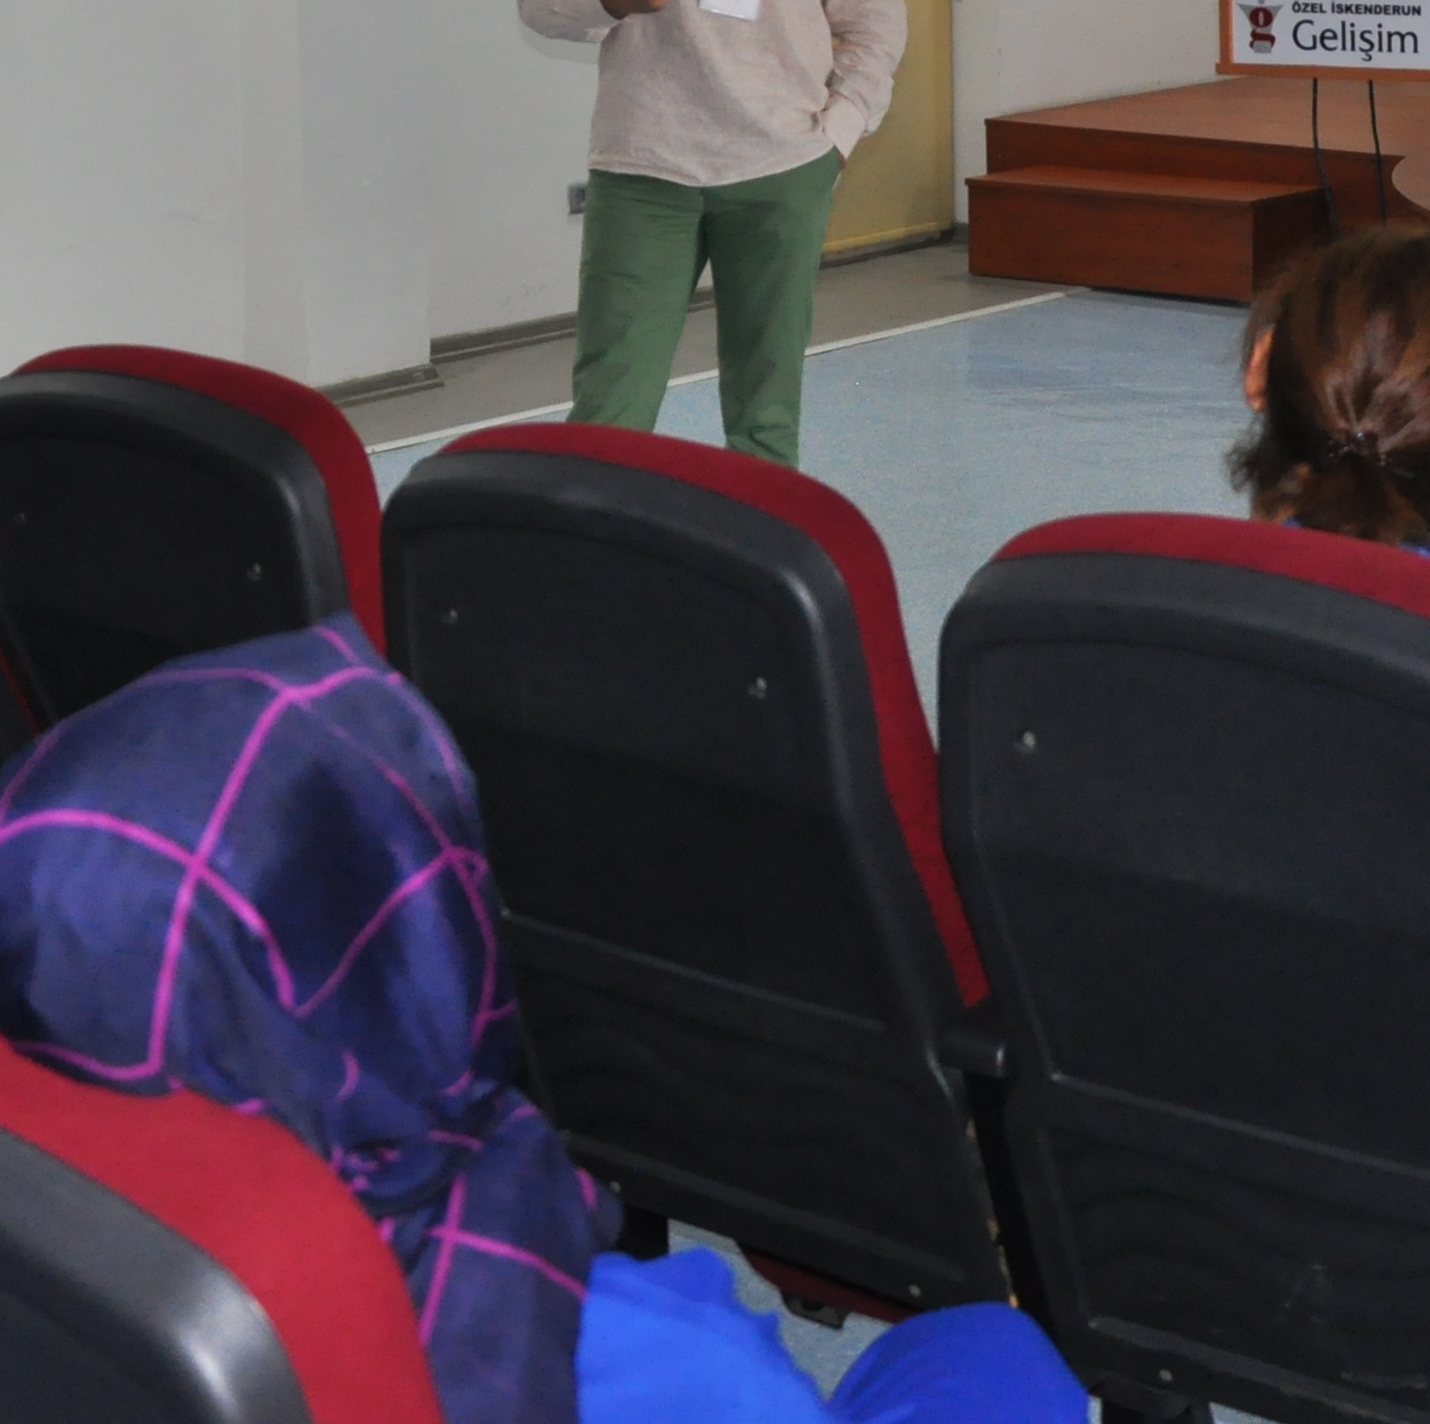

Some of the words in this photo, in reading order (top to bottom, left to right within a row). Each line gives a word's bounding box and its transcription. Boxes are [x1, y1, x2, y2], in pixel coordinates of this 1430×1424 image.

[1291, 0, 1327, 14] ÖZEL
[1331, 0, 1422, 16] İSKENDERUN
[1292, 19, 1419, 62] Gelişim
